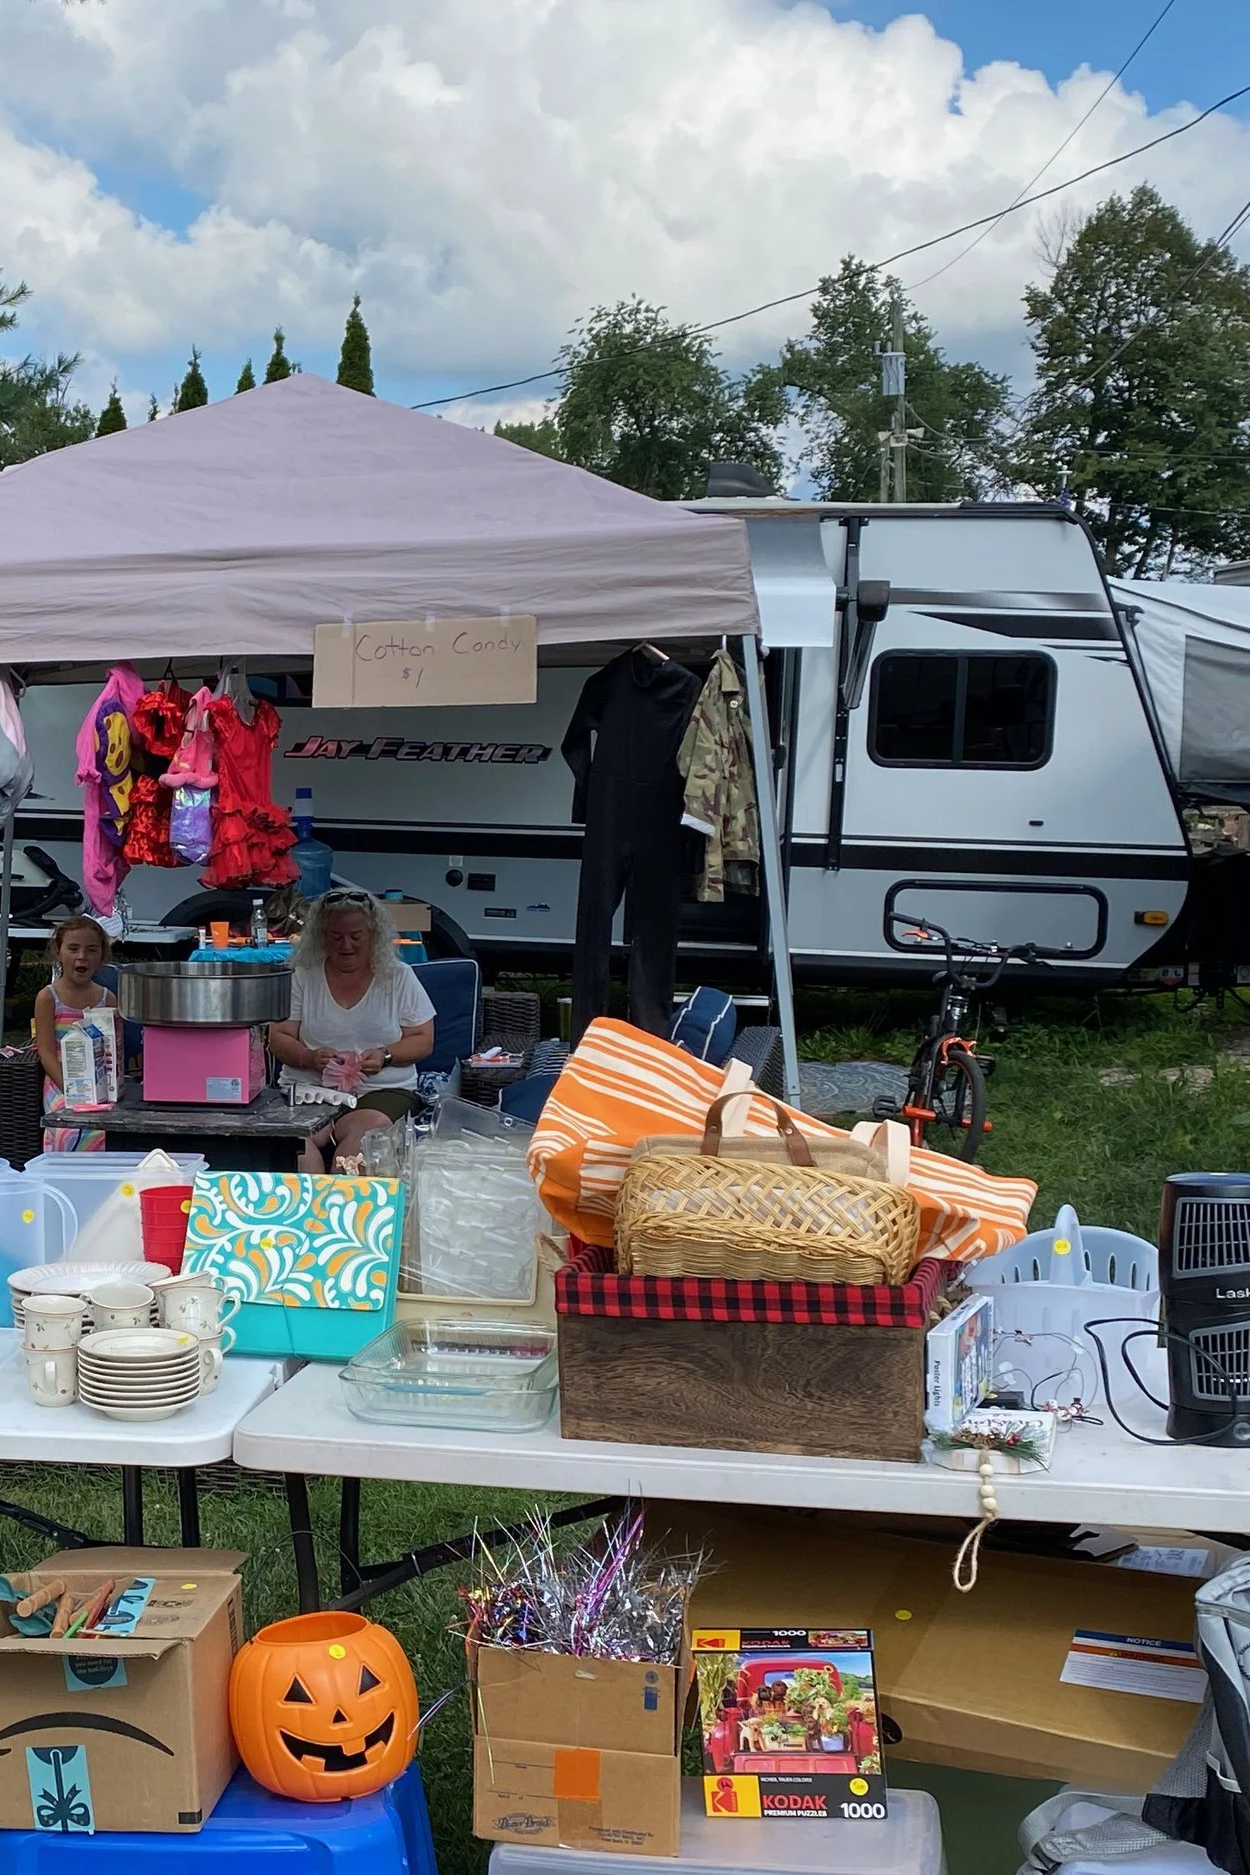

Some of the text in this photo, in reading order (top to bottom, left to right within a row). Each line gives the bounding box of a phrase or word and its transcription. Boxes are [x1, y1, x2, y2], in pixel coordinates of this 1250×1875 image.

[355, 631, 523, 662] Cotton Candy
[402, 667, 424, 689] $1
[284, 736, 548, 765] JAY FEATHER
[1126, 1637, 1162, 1647] NOTICE
[762, 1794, 828, 1809] KODAK
[839, 1803, 886, 1818] 1000
